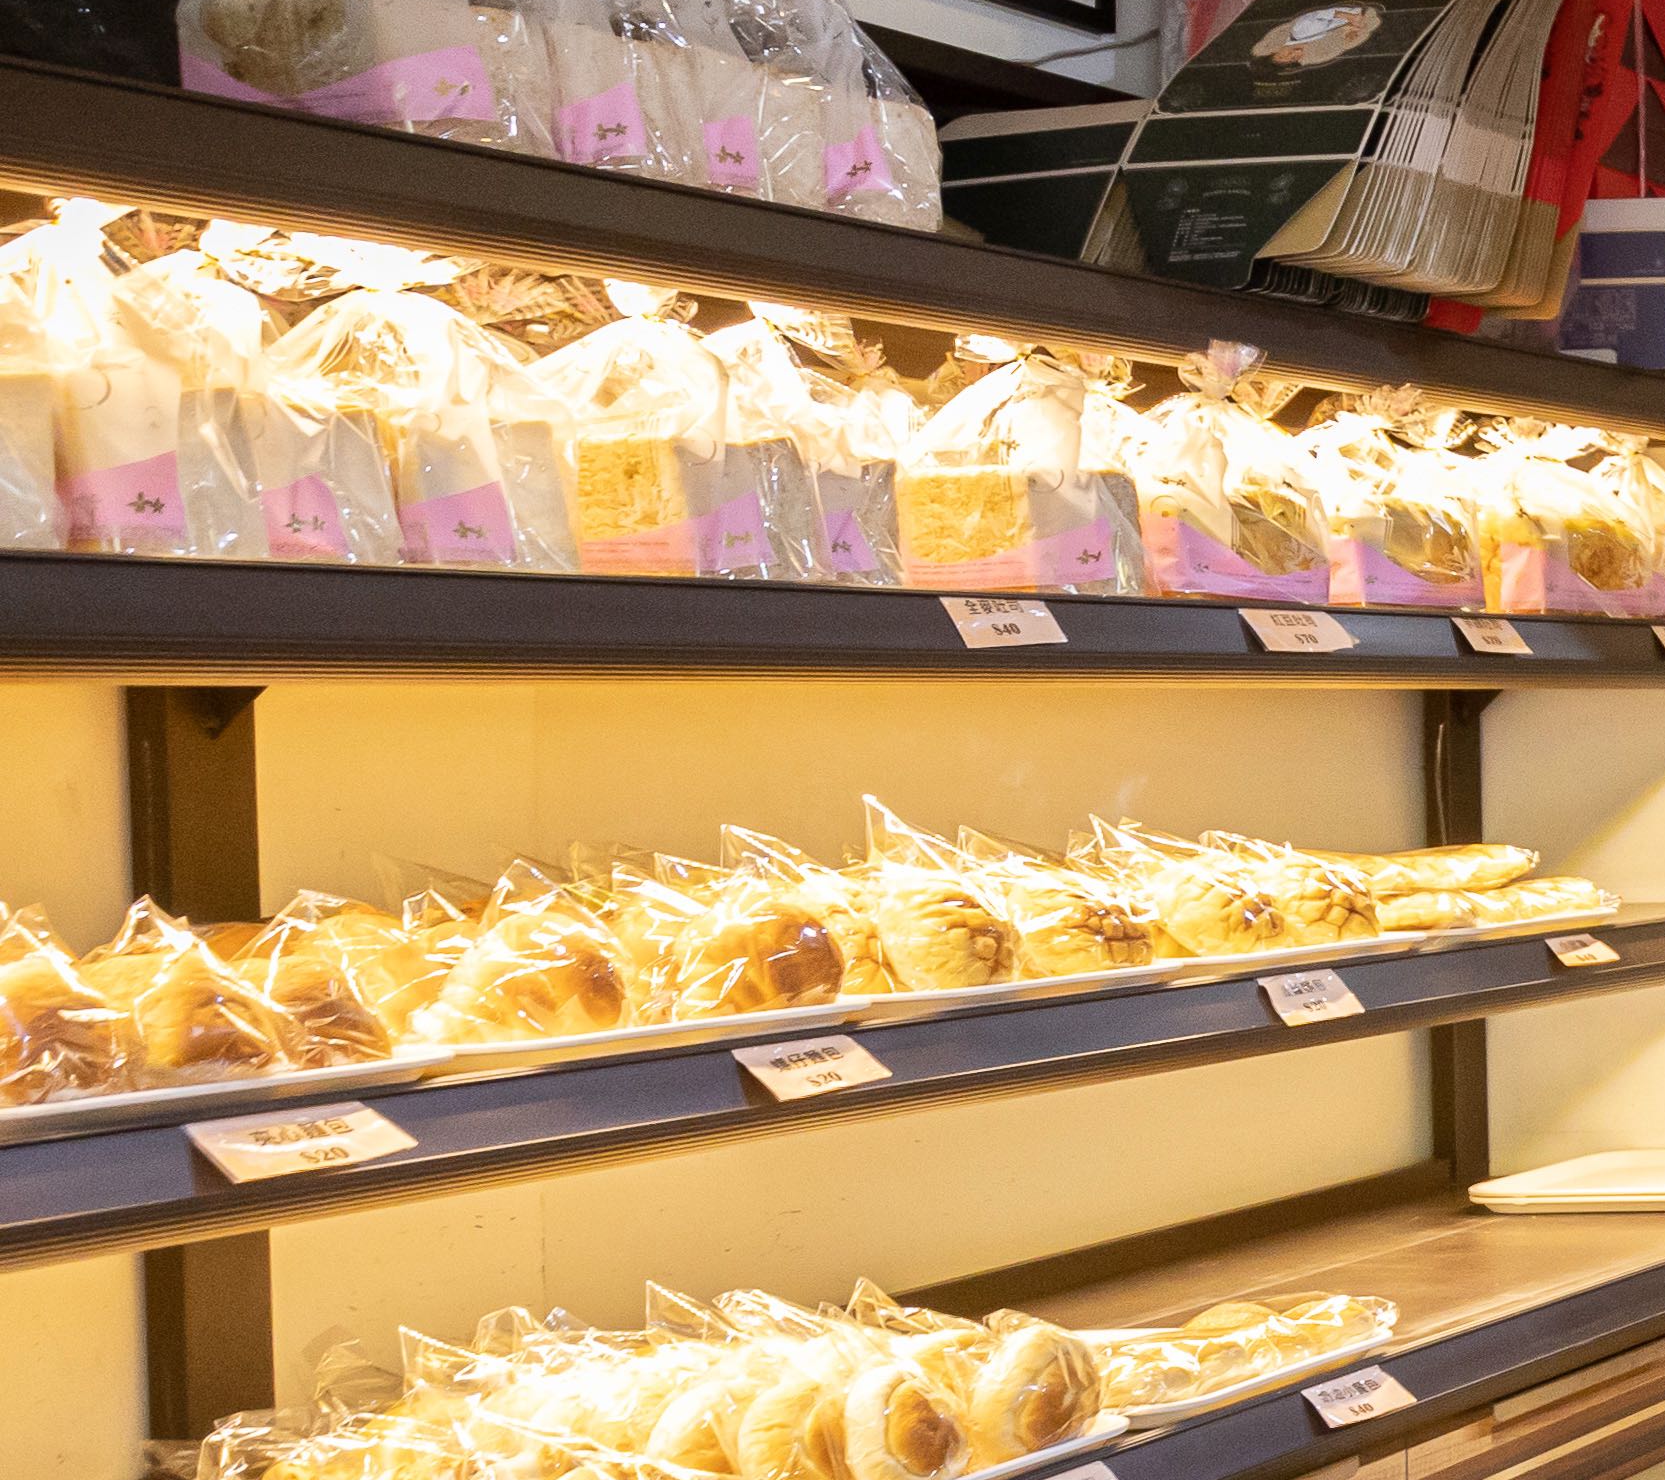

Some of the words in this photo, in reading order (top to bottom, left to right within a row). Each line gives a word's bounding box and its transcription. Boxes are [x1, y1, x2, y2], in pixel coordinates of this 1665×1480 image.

[991, 623, 1022, 637] $40
[1294, 631, 1319, 645] $70
[806, 1071, 843, 1087] $20
[299, 1146, 350, 1164] $20
[1348, 1402, 1376, 1418] $40
